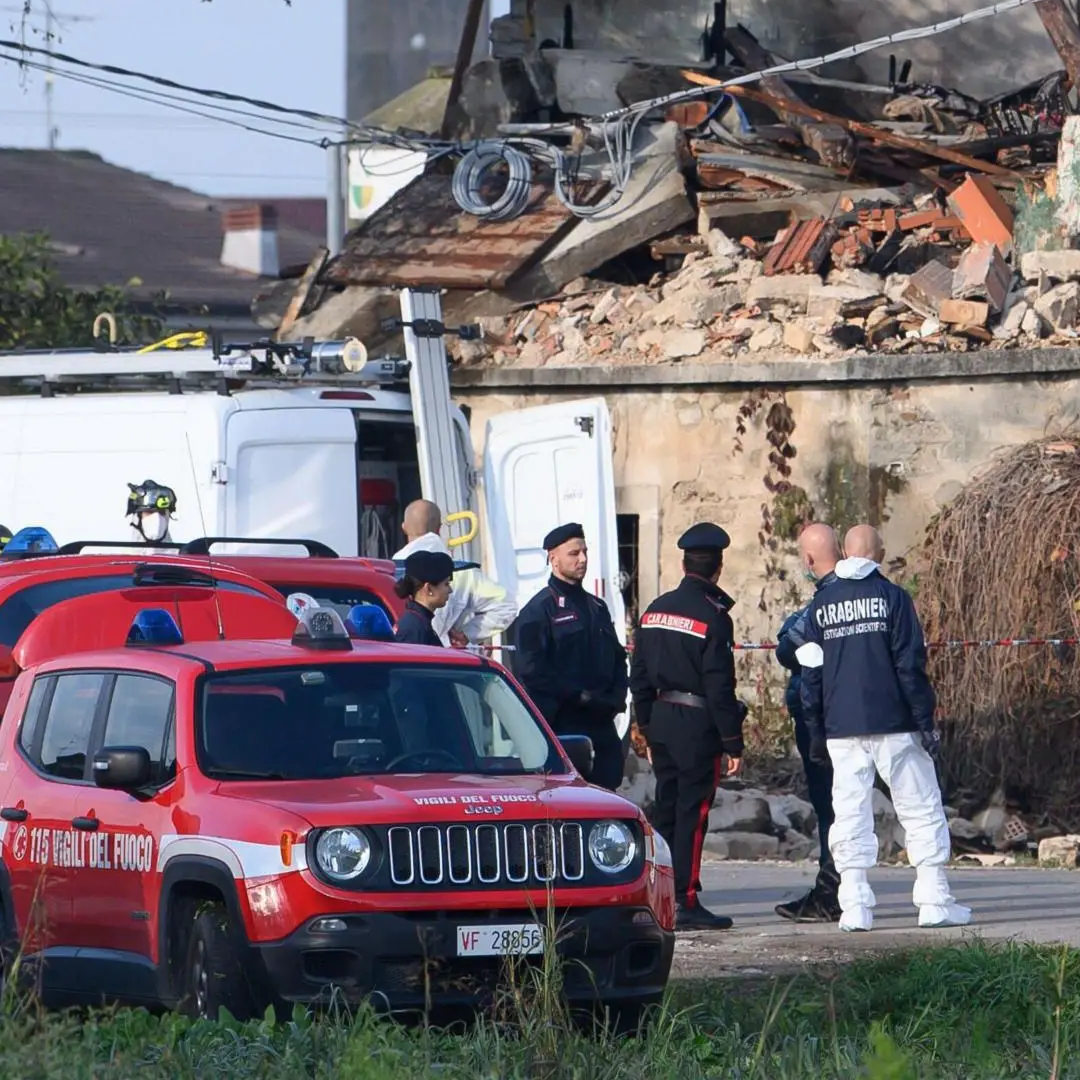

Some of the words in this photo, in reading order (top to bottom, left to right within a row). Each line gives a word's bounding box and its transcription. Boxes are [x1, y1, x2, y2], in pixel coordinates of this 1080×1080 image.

[815, 597, 888, 628] CARABINIER
[413, 796, 457, 806] VIGILI
[460, 795, 489, 804] DEL
[490, 794, 537, 803] FUOCO
[464, 804, 504, 816] Jeep
[29, 826, 49, 865] 115
[52, 829, 86, 868] VIGILI
[89, 831, 112, 870] DEL
[113, 833, 153, 872] FUOCO
[461, 931, 480, 951] VF
